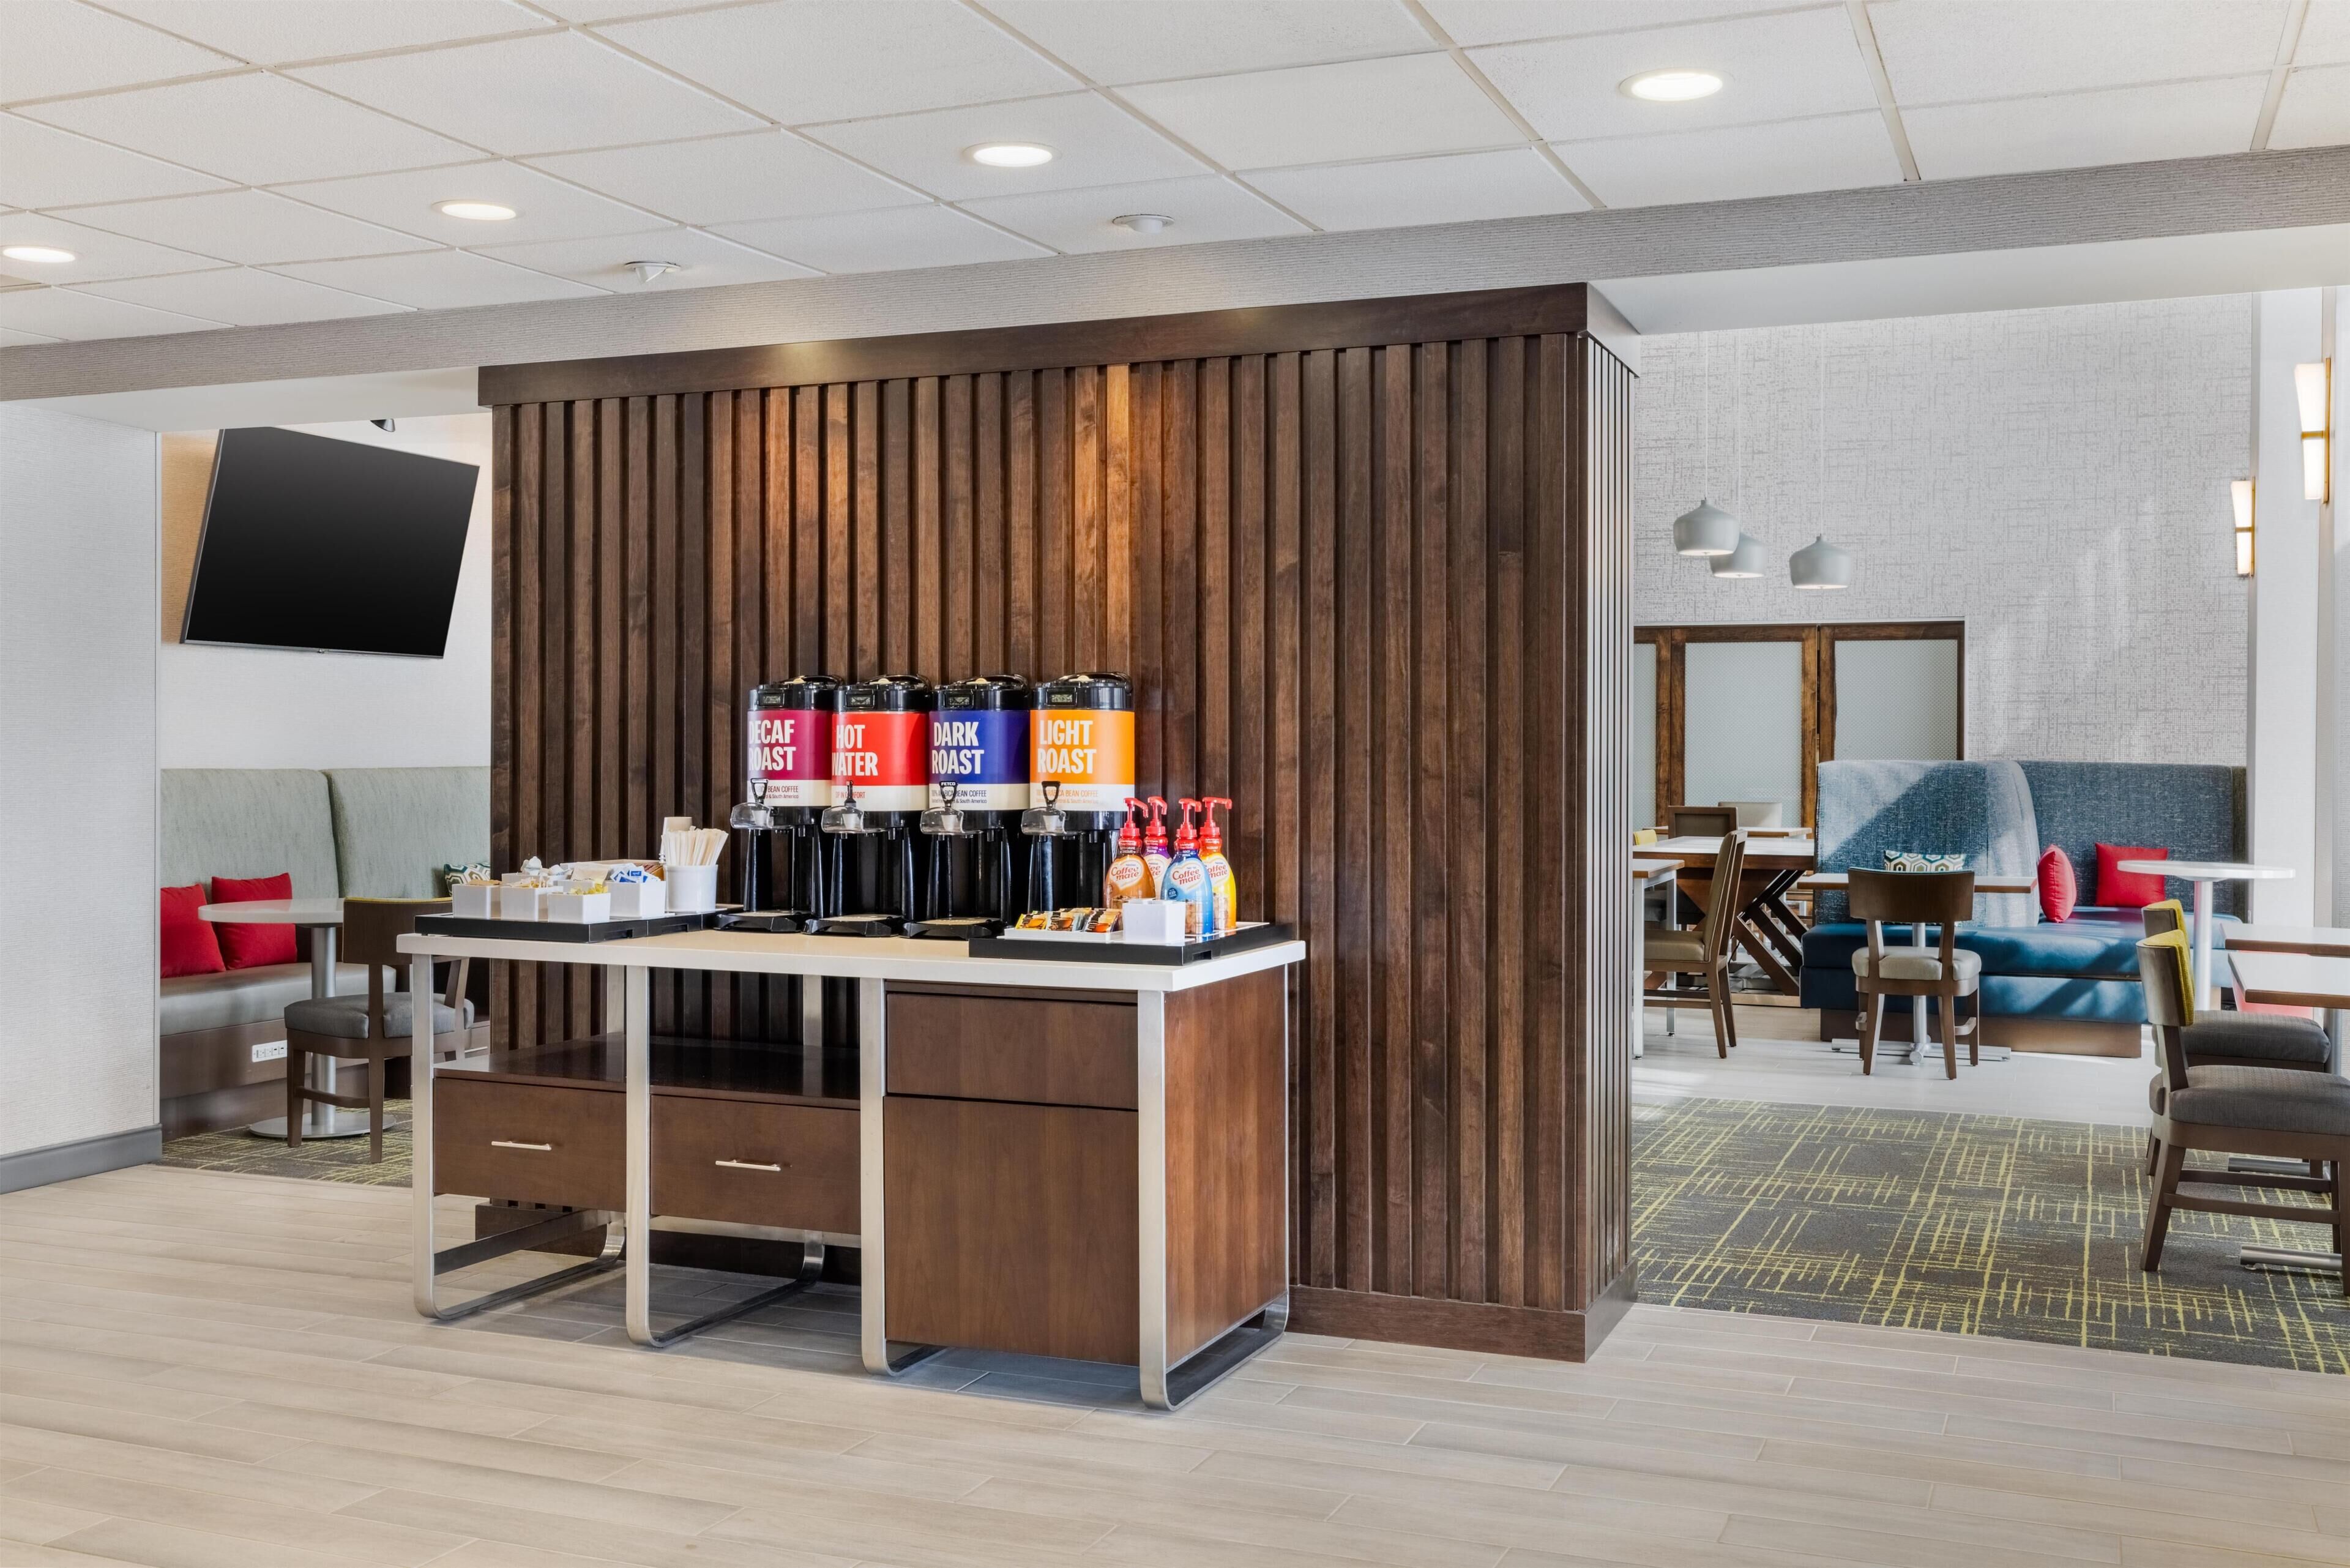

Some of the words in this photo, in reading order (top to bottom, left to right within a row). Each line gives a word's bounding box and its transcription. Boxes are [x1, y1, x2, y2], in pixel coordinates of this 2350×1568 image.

[748, 719, 795, 744] DECAF
[835, 725, 866, 749] HOT
[934, 722, 979, 747] DARK
[1039, 720, 1094, 745] LIGHT
[748, 745, 797, 771] ROAST
[932, 749, 985, 775] ROAST
[1037, 748, 1097, 774] ROAST
[1111, 867, 1139, 876] Coffee
[1116, 872, 1139, 881] mate
[1172, 869, 1199, 880] Coffee
[1179, 874, 1201, 885] mate
